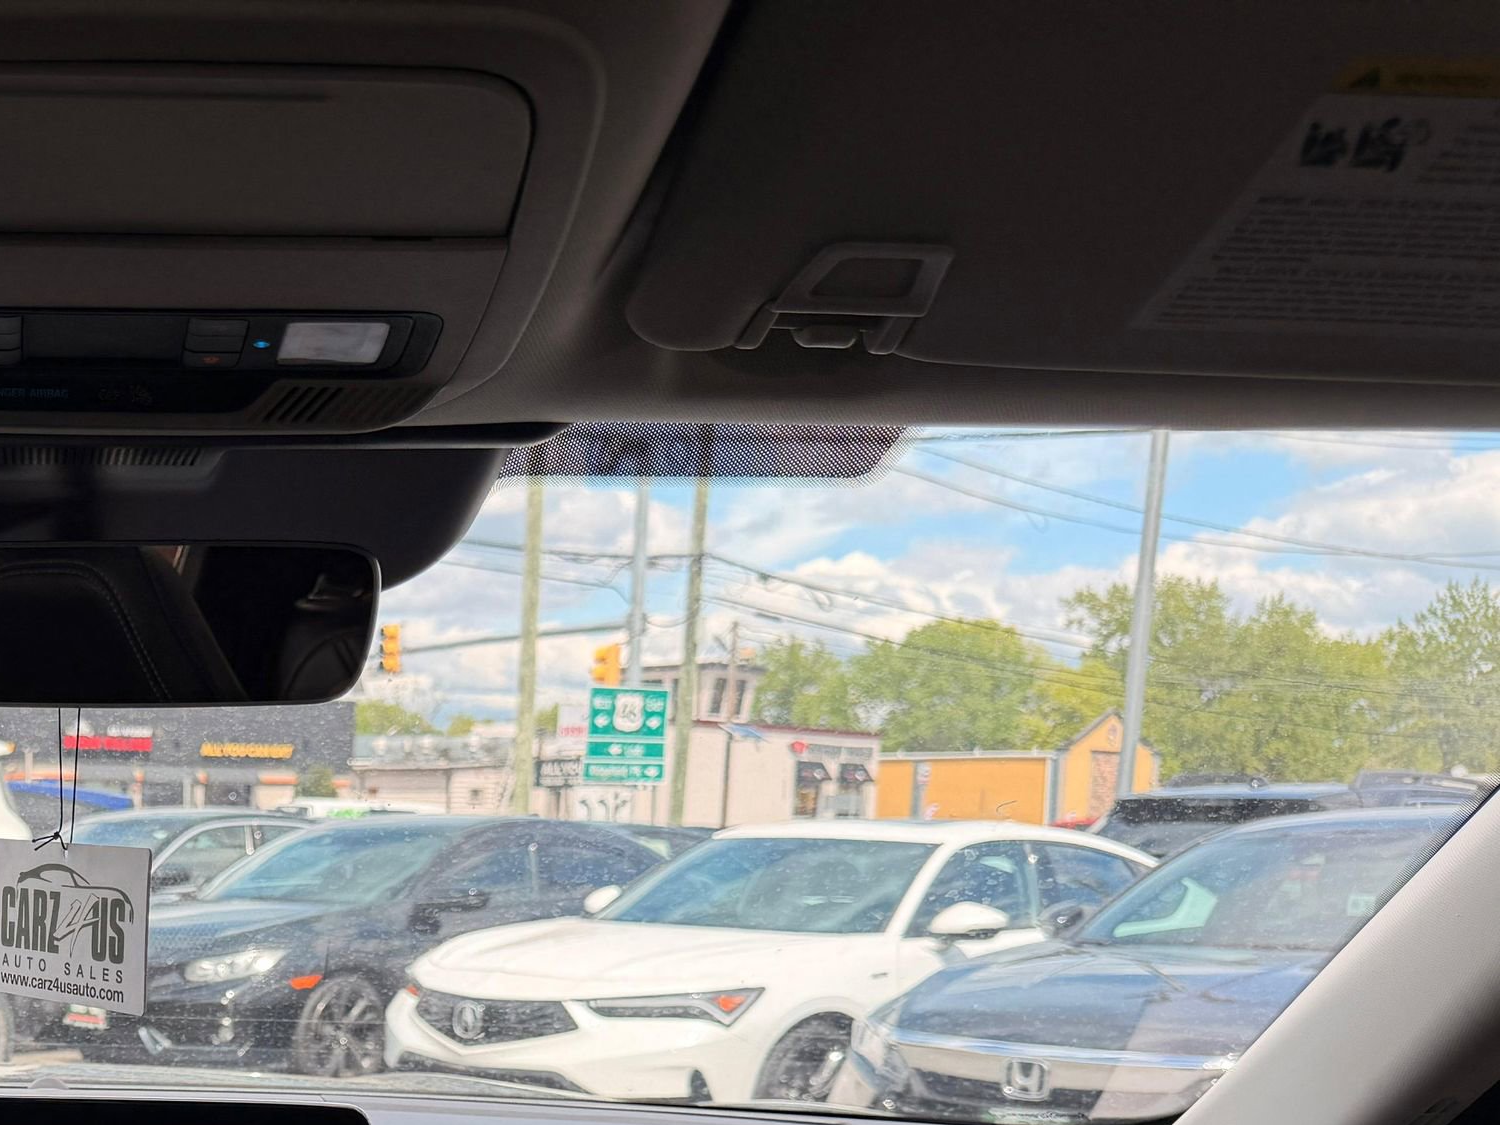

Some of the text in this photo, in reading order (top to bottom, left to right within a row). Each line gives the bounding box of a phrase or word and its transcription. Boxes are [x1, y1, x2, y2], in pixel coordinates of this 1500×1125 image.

[2, 952, 124, 984] AUTO SALES
[0, 970, 124, 1003] www.carz4usauto.com
